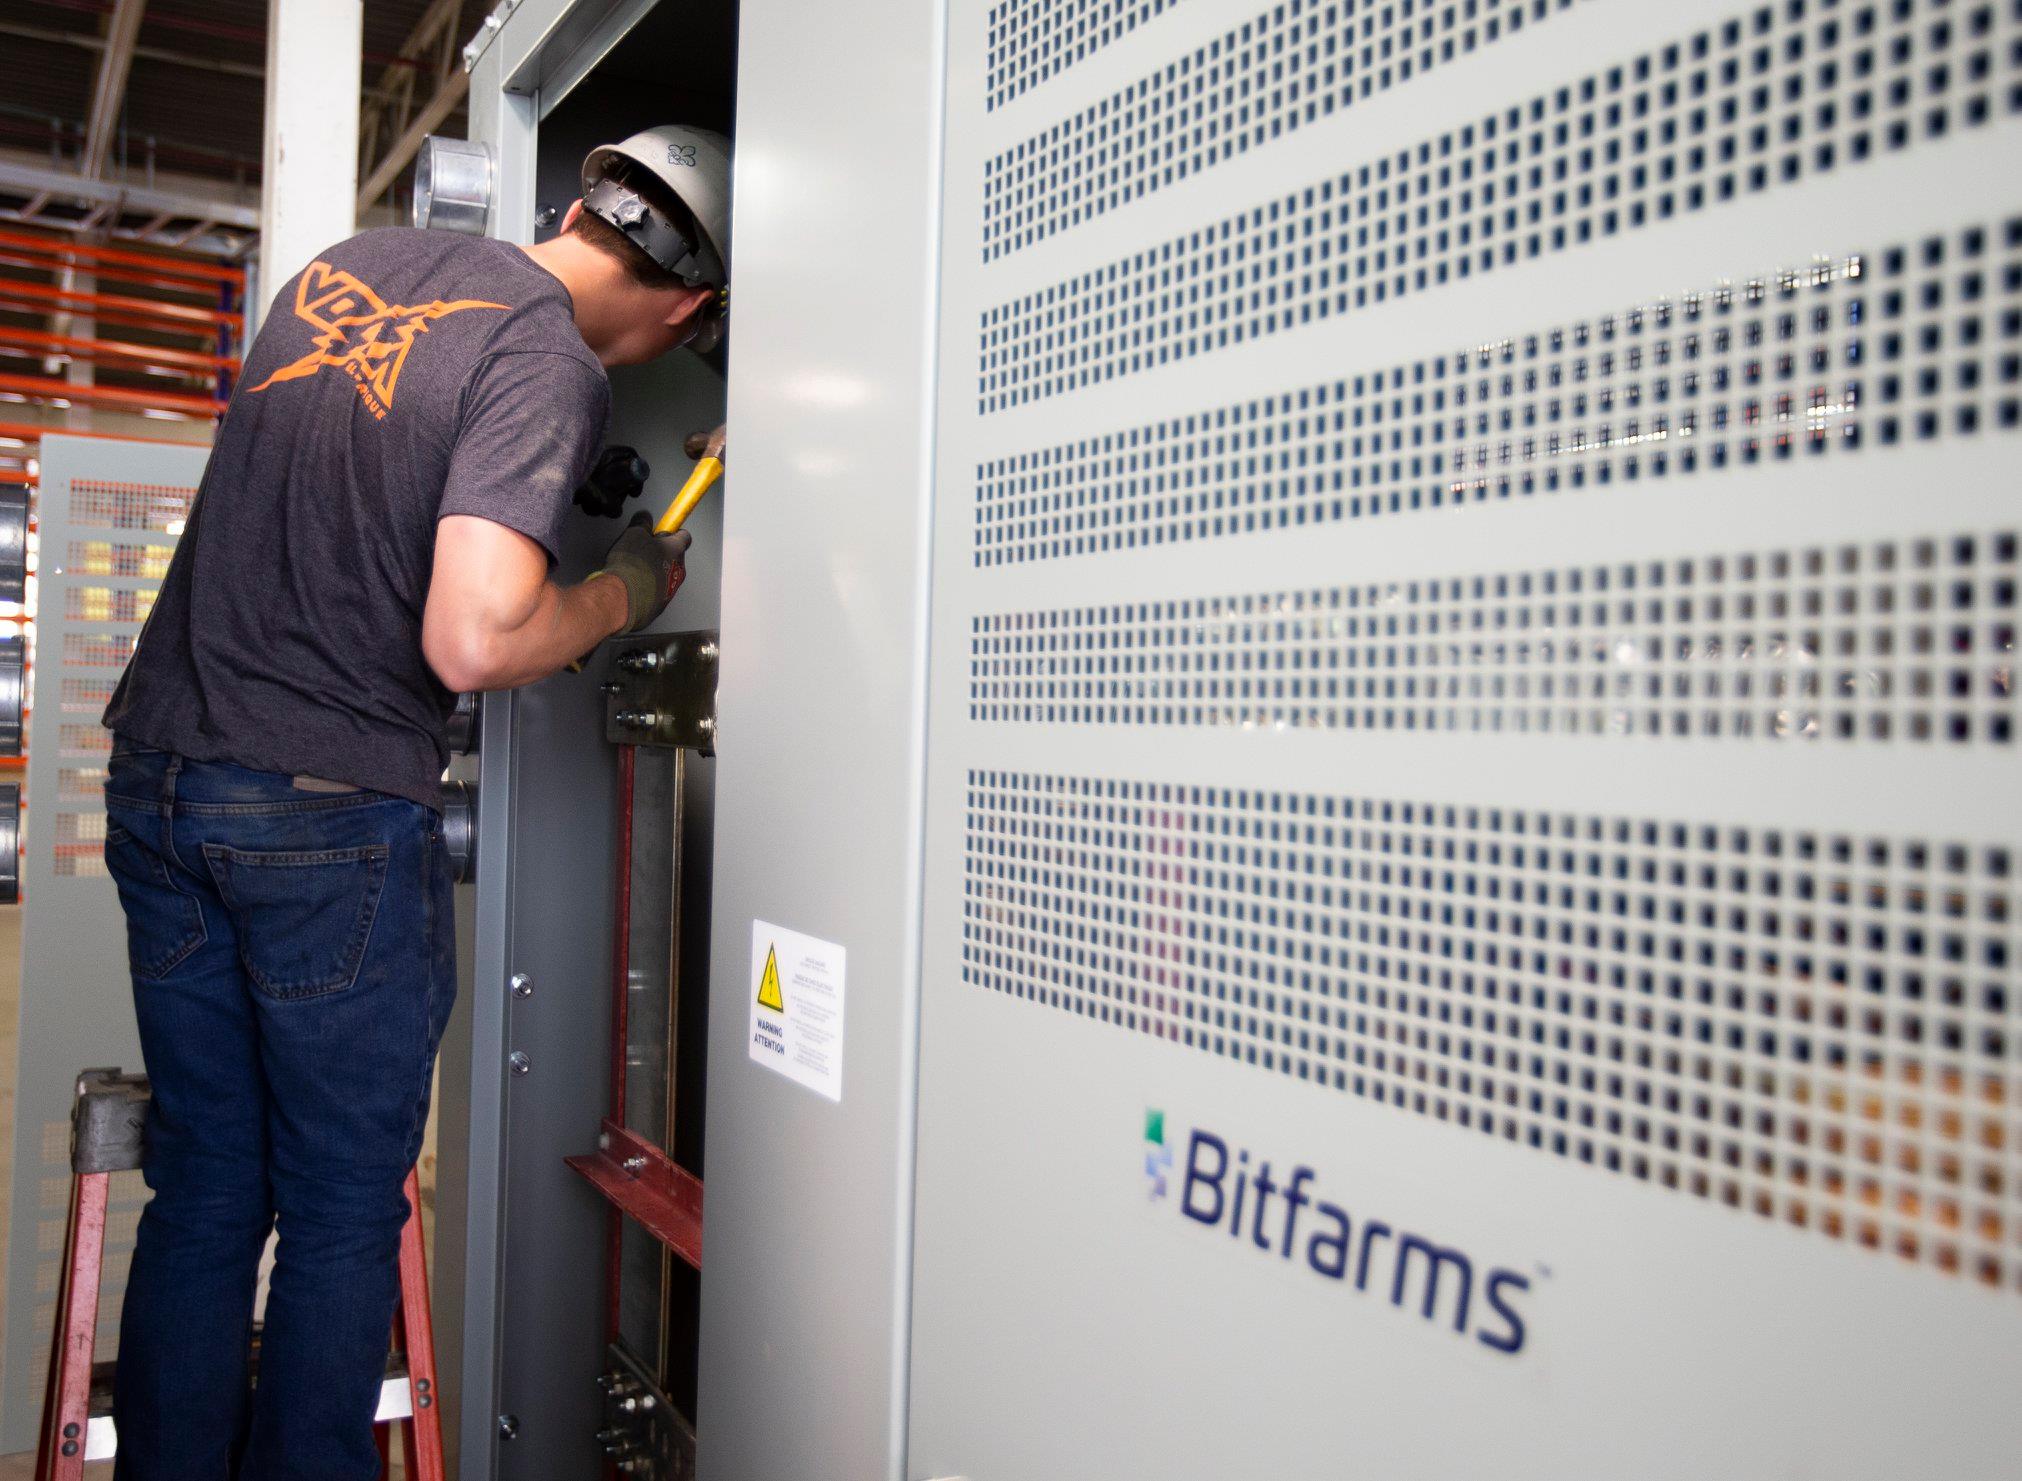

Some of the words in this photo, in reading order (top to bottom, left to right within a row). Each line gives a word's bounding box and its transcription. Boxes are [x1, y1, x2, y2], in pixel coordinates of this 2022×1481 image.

[757, 1017, 783, 1038] WARNING
[754, 1033, 785, 1055] ATTENTION
[1180, 1127, 1531, 1356] Bitfarms
